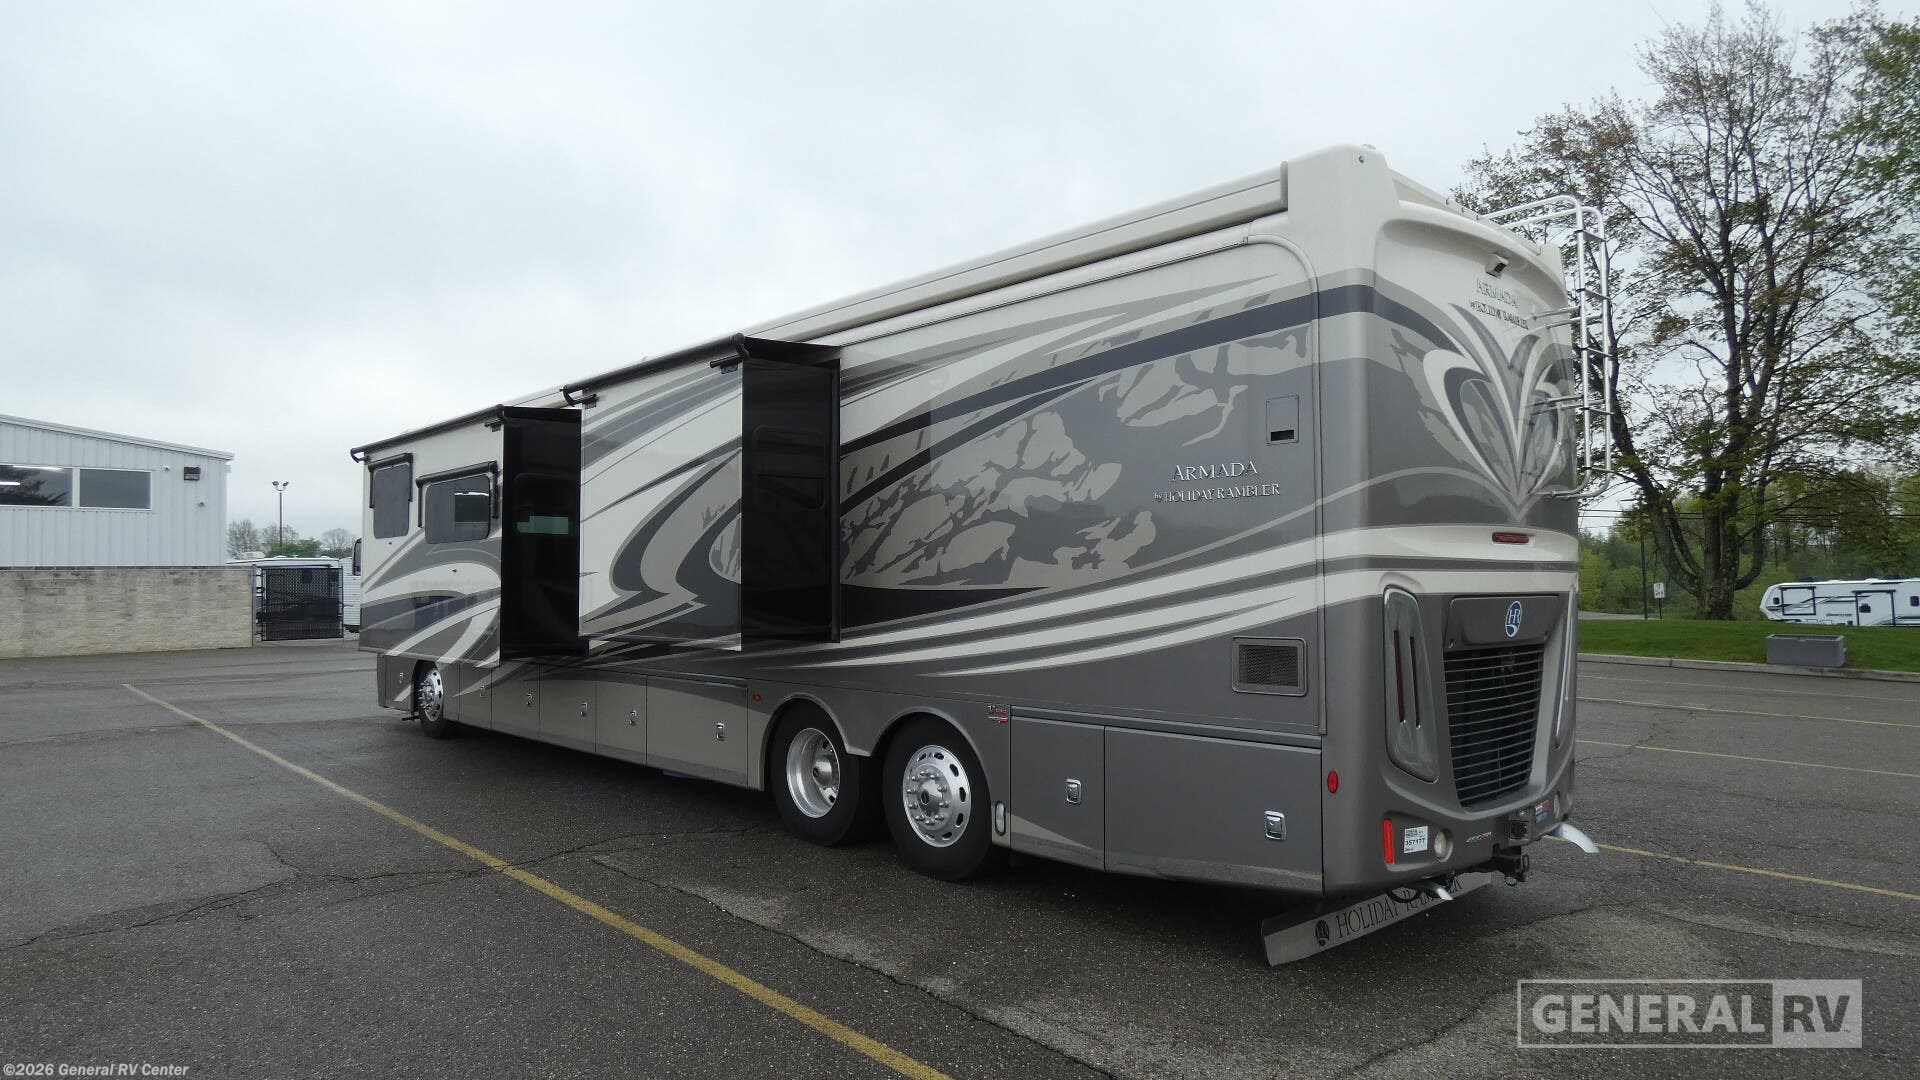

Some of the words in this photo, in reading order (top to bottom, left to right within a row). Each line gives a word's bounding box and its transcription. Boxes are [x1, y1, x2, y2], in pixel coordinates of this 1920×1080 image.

[1172, 461, 1258, 481] ARMADA
[1165, 488, 1215, 502] HOLIDAY
[1217, 484, 1280, 500] RAMBLER
